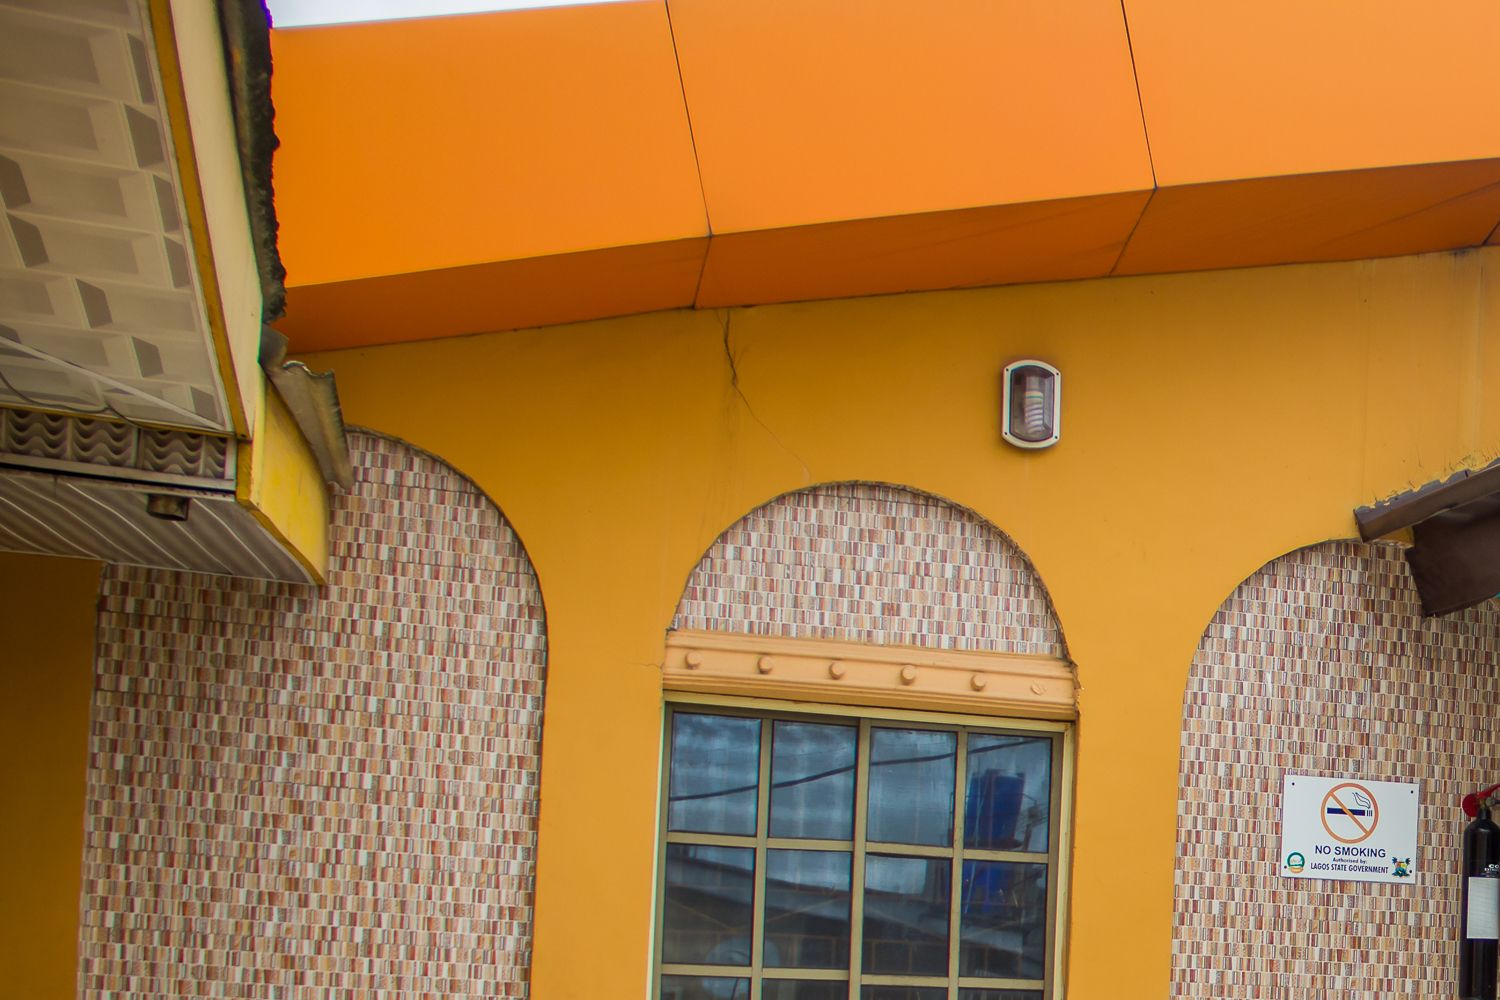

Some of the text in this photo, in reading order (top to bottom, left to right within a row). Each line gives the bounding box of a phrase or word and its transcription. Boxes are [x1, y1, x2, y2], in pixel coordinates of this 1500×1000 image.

[1315, 845, 1386, 858] NO SMOKING
[1310, 862, 1389, 874] LAGOS STATE GOVERNMENT
